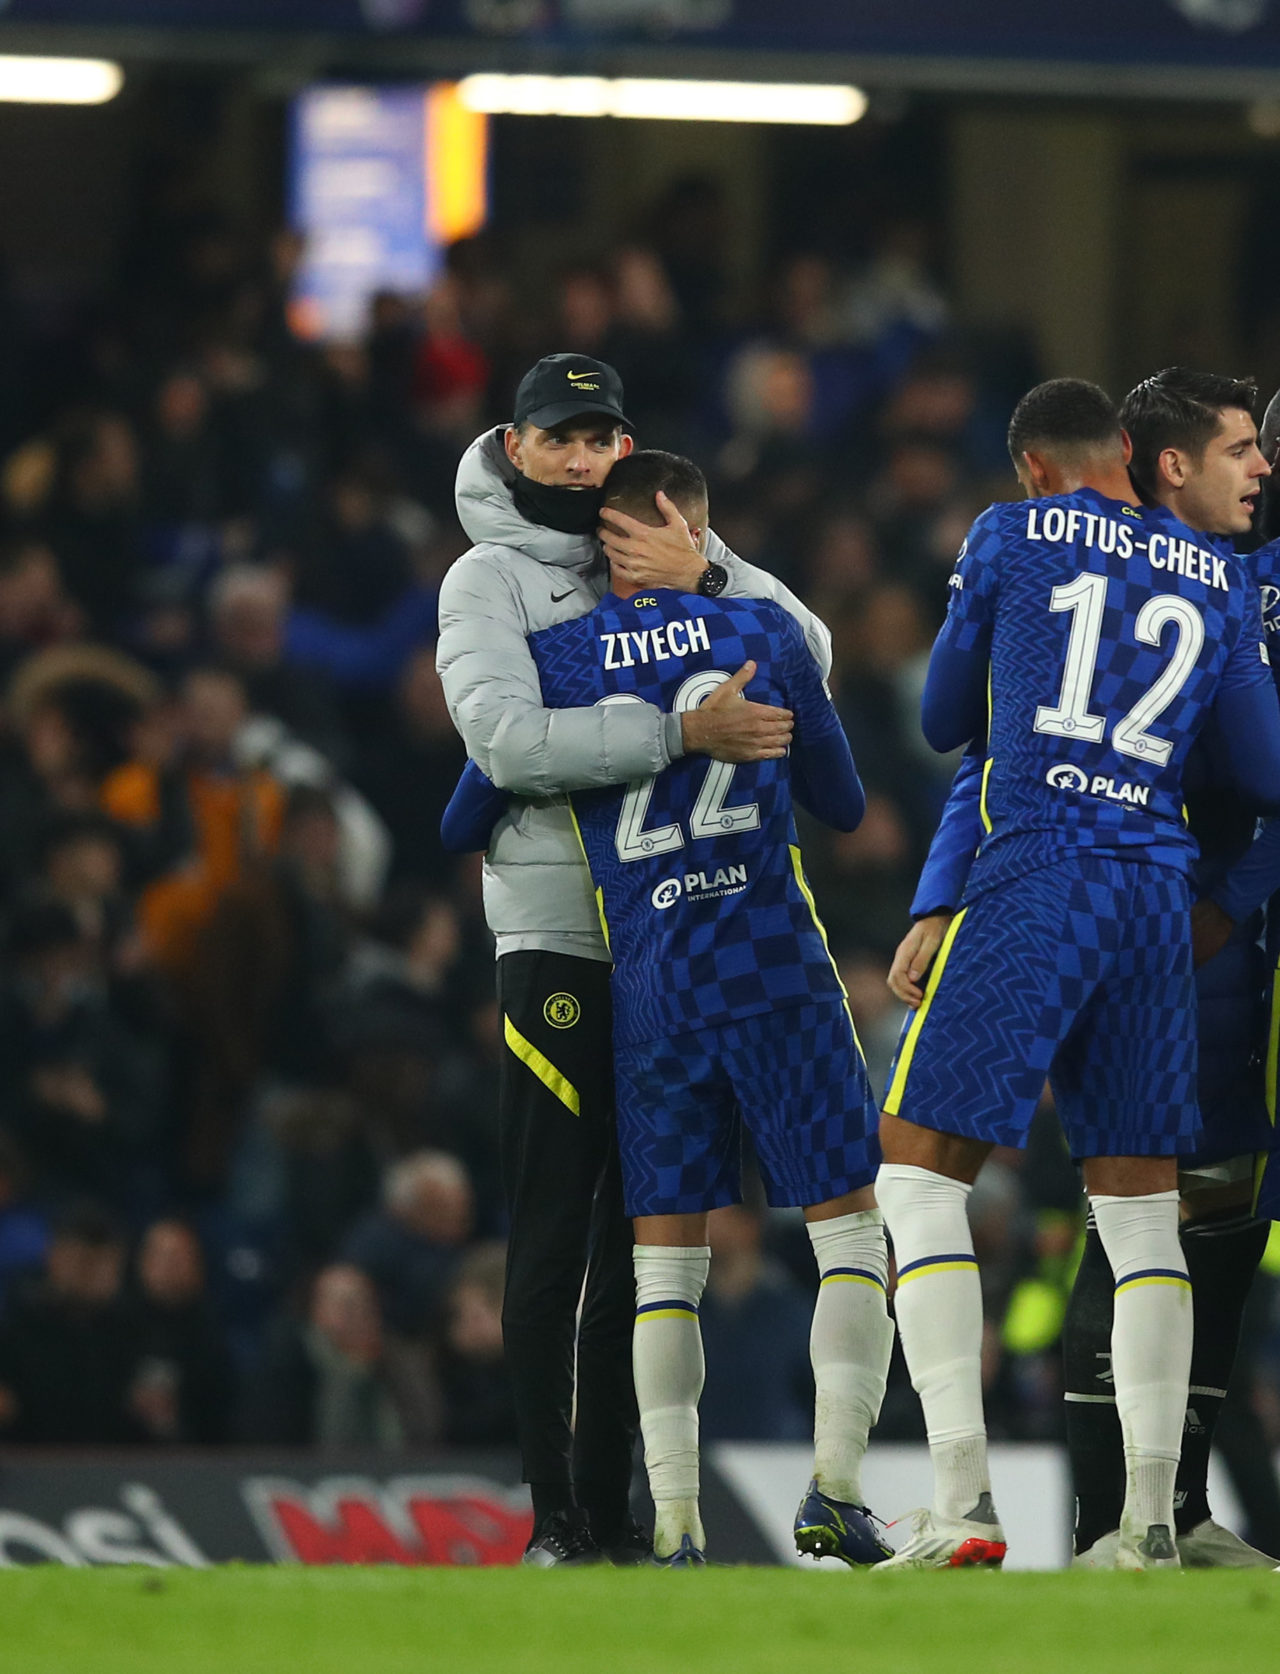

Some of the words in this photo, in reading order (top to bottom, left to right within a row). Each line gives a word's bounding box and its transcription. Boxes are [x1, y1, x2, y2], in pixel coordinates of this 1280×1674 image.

[1026, 507, 1230, 592] LOFTUS-CHEEK
[633, 597, 658, 608] CFC
[599, 617, 711, 671] ZIYECH
[1033, 571, 1205, 768] 12
[1090, 775, 1151, 806] PLAN
[683, 863, 748, 892] PLAN
